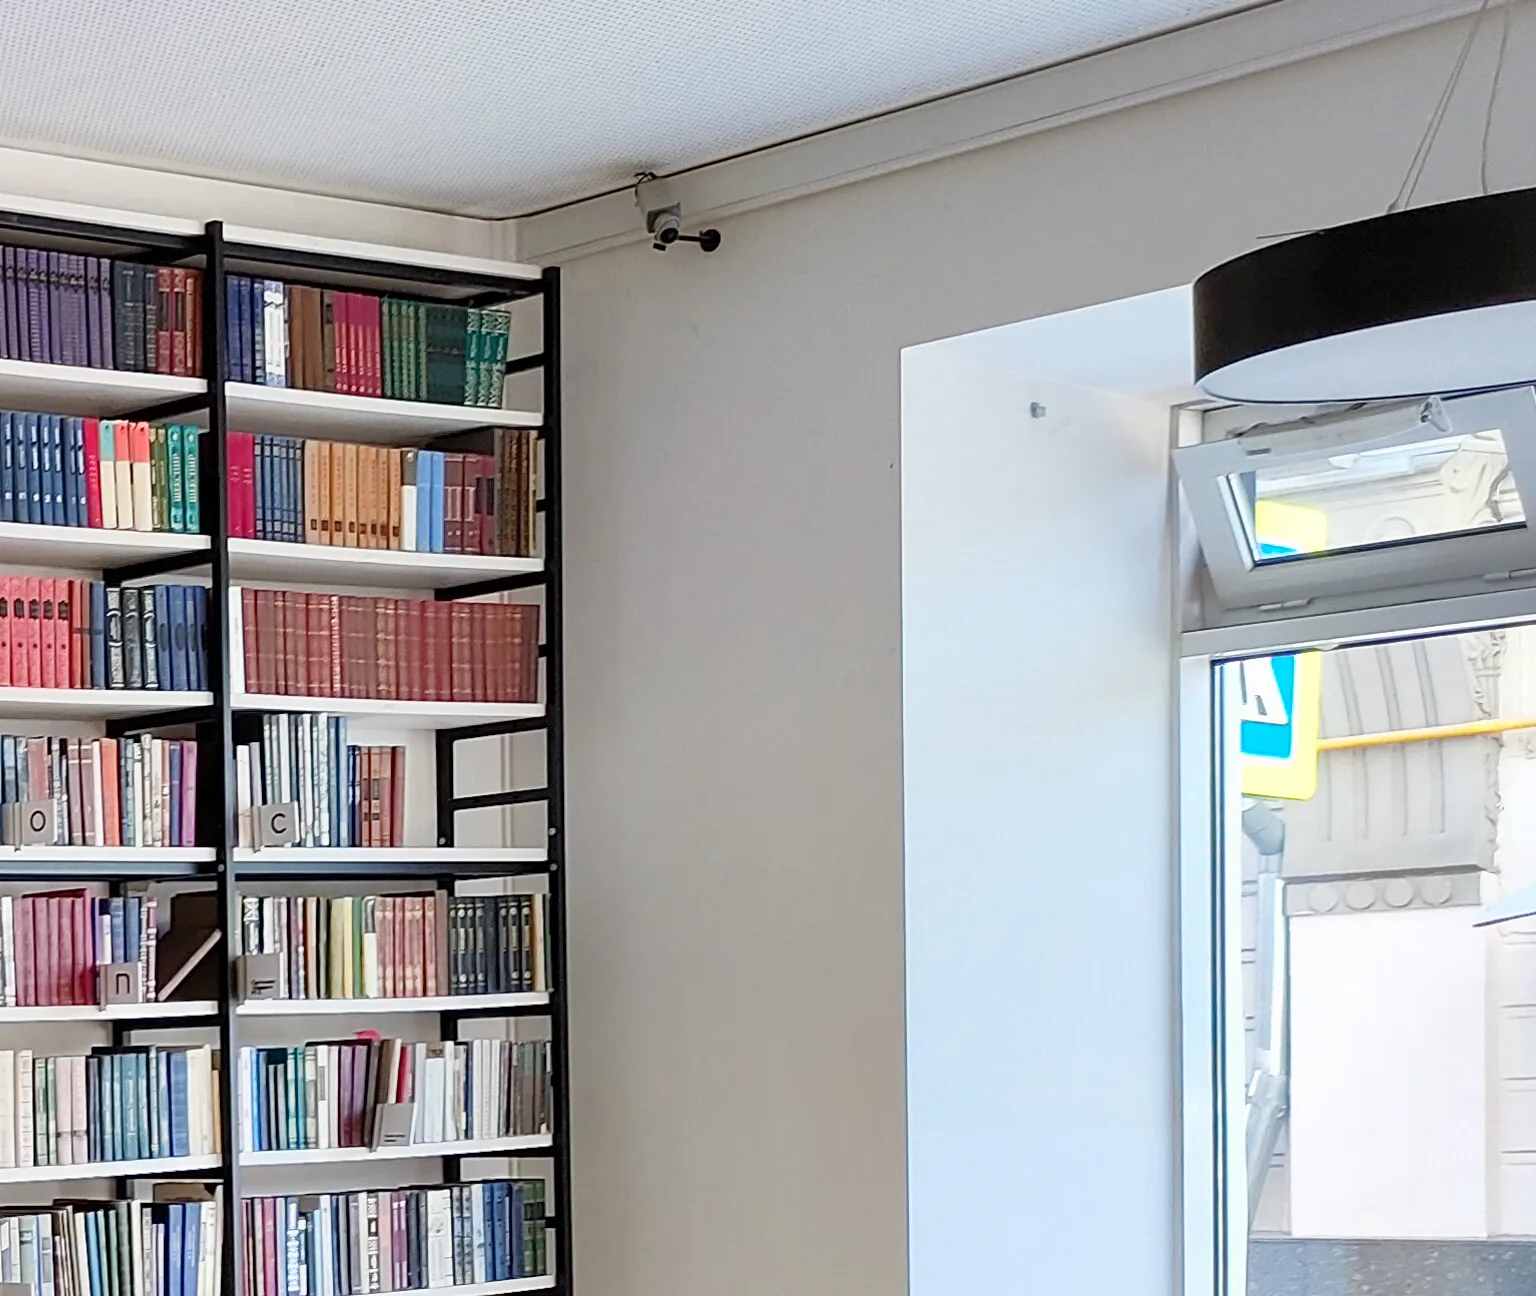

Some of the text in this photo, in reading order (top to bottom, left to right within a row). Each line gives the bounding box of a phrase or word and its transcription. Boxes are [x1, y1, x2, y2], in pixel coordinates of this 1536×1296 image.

[30, 810, 46, 831] О
[271, 812, 287, 834] С
[115, 973, 130, 995] П
